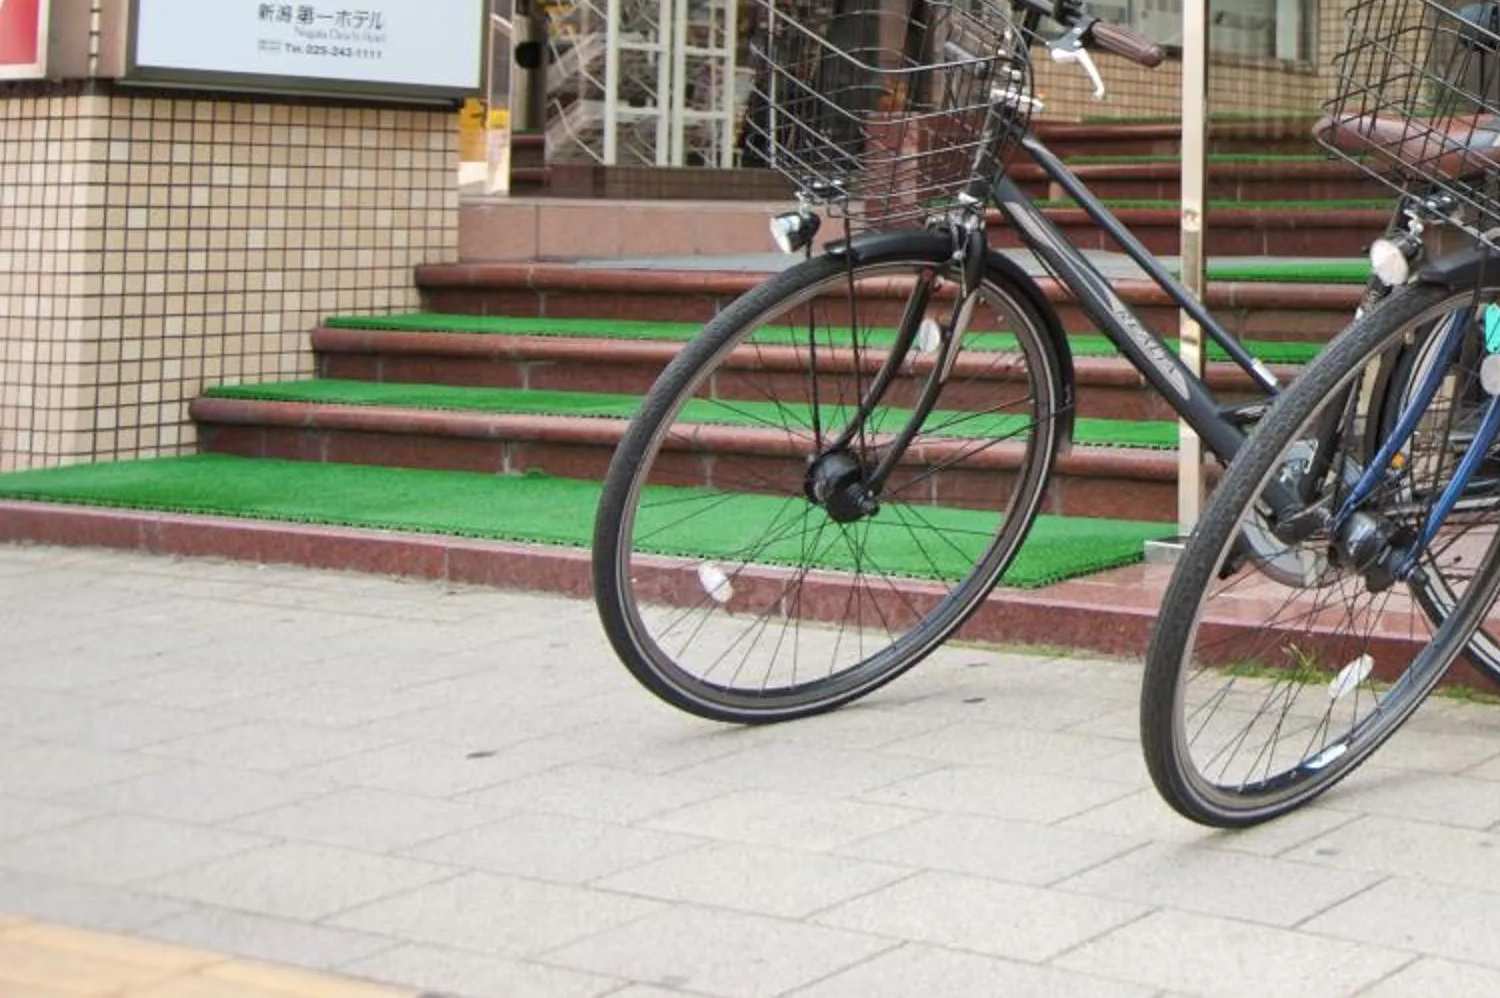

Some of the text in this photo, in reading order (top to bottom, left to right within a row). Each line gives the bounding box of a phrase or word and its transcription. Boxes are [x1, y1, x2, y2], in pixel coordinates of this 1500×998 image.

[258, 3, 383, 30] 新潟第一ホテル
